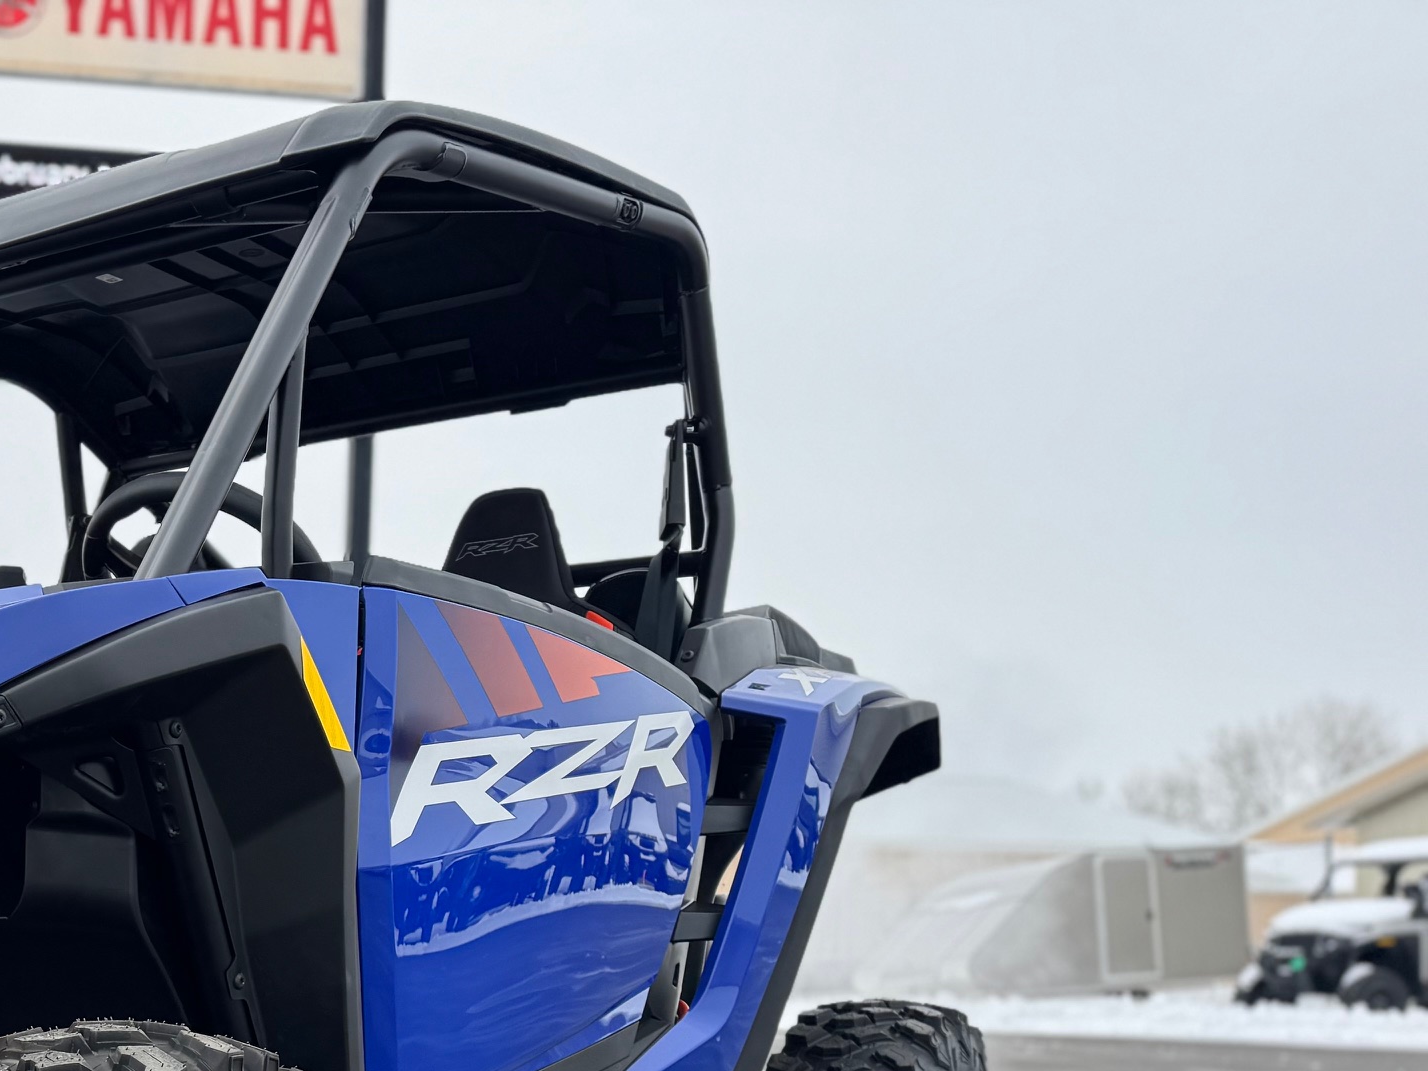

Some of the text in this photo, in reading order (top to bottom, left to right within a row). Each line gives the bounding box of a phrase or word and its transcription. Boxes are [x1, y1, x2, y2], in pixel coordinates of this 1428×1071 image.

[61, 0, 339, 55] YAMAHA
[455, 533, 539, 562] RZR
[390, 711, 695, 848] RZR
